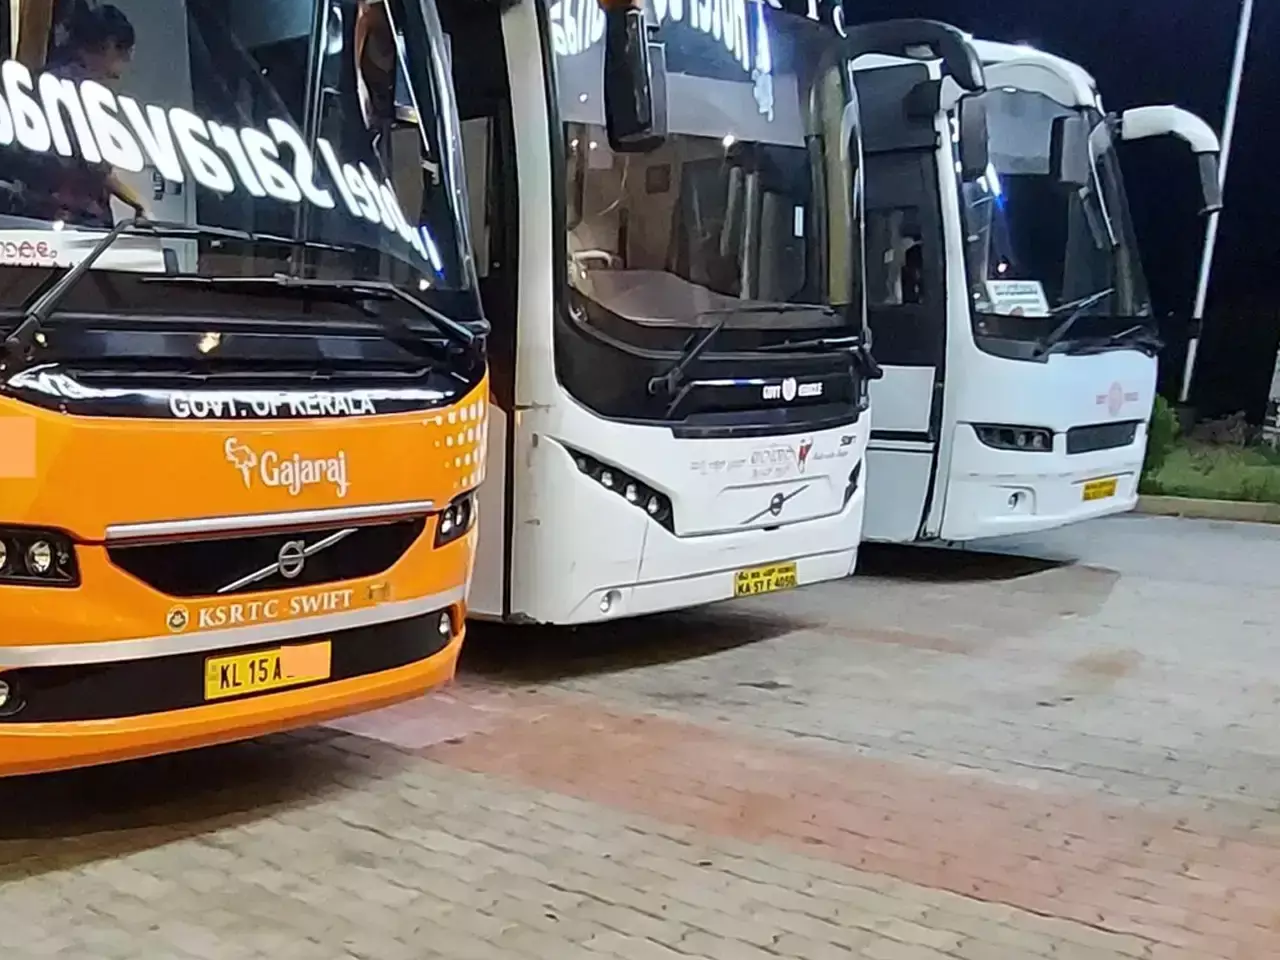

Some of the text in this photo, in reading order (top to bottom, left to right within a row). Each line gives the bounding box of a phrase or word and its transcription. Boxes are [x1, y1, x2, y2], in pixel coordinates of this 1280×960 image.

[260, 451, 352, 499] Gajaraj
[199, 599, 280, 628] KSRTC
[289, 589, 354, 615] SWIFT
[220, 663, 242, 690] KL
